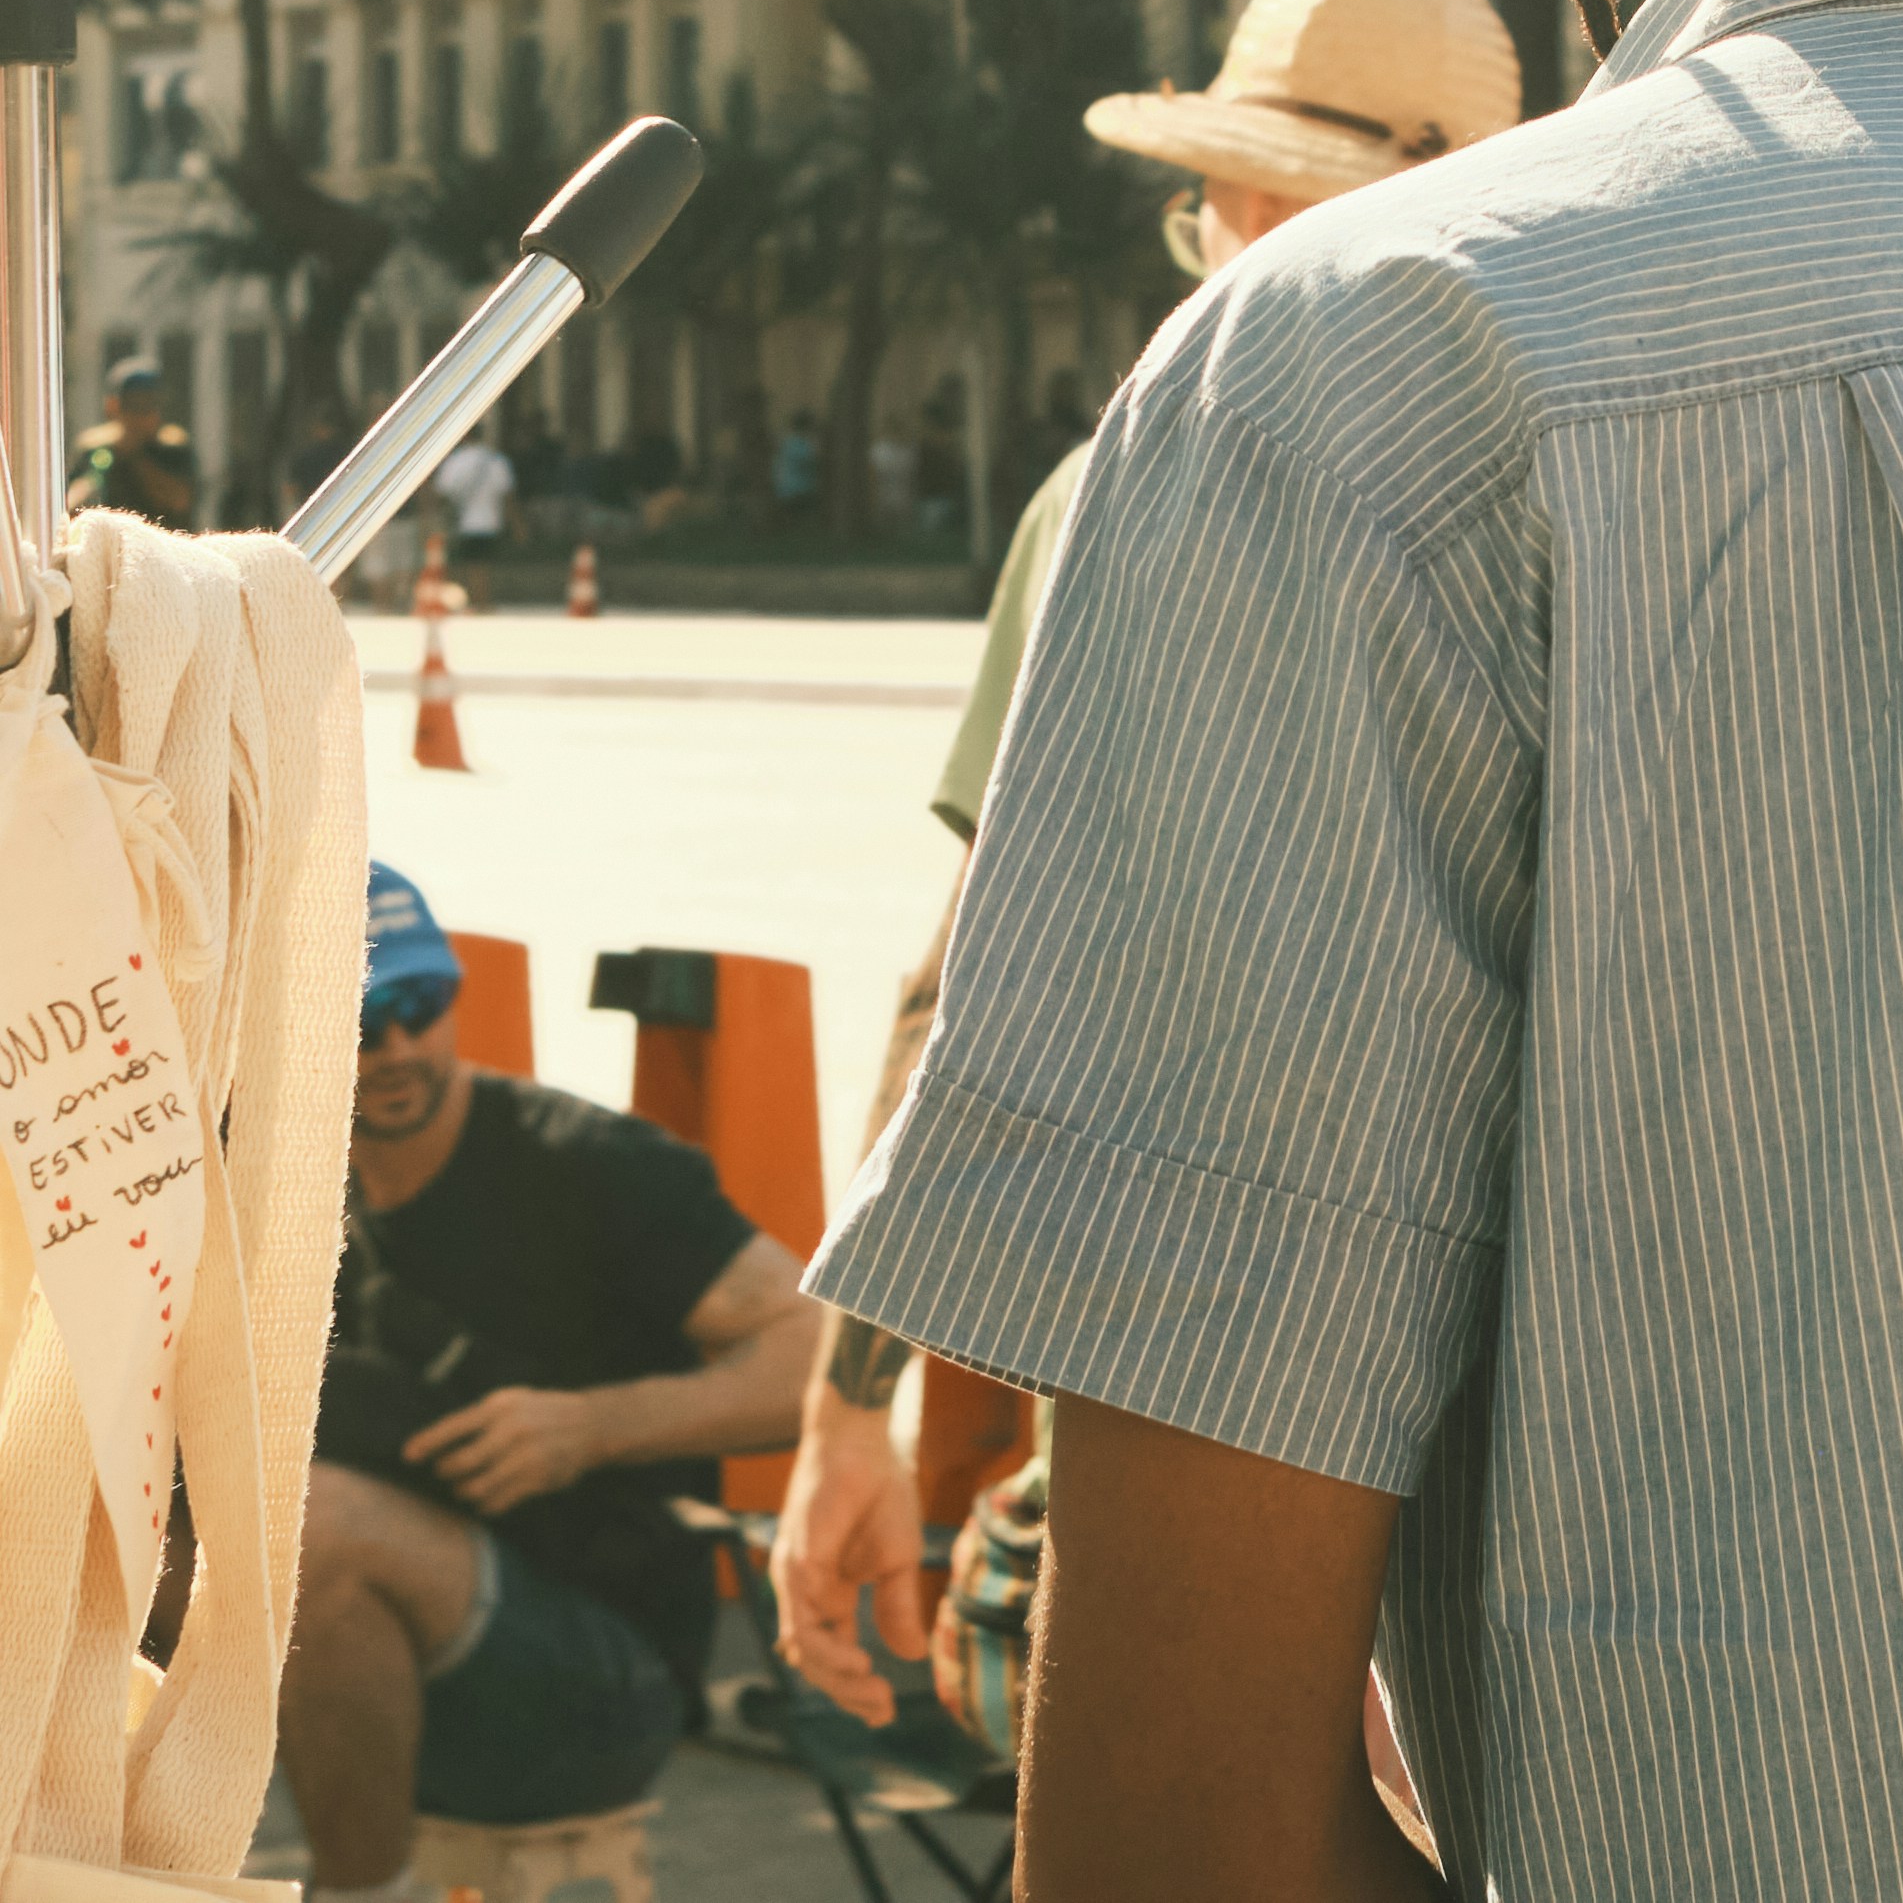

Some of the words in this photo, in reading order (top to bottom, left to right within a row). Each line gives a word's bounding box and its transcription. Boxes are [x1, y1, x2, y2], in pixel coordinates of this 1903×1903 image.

[53, 1050, 169, 1123] amor
[42, 1212, 98, 1250] eu
[113, 1157, 203, 1206] vou
